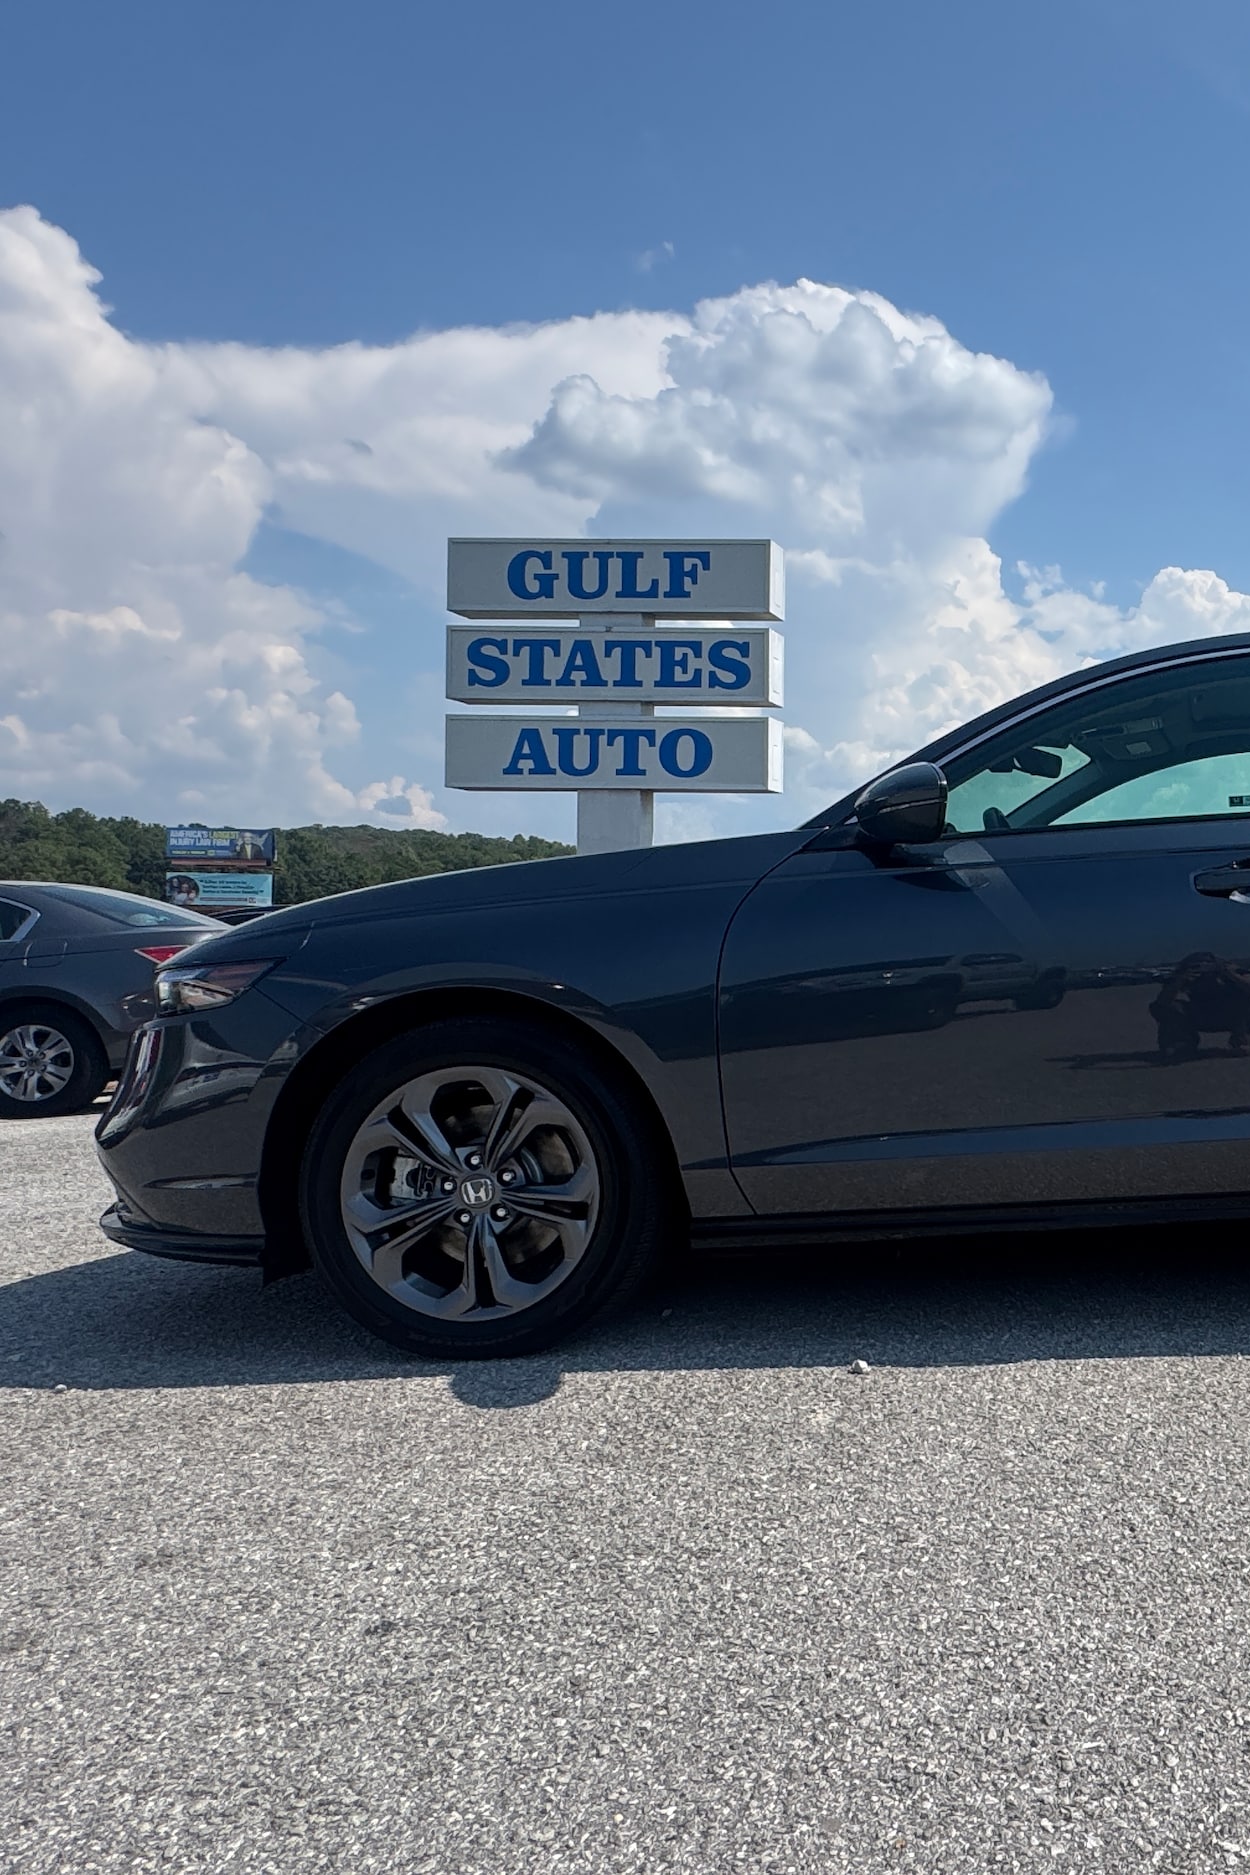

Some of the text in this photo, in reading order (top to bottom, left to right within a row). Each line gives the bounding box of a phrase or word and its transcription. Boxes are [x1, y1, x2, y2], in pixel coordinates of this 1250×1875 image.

[507, 550, 710, 600] GULF
[466, 637, 751, 690] STATES
[502, 728, 713, 778] AUTO
